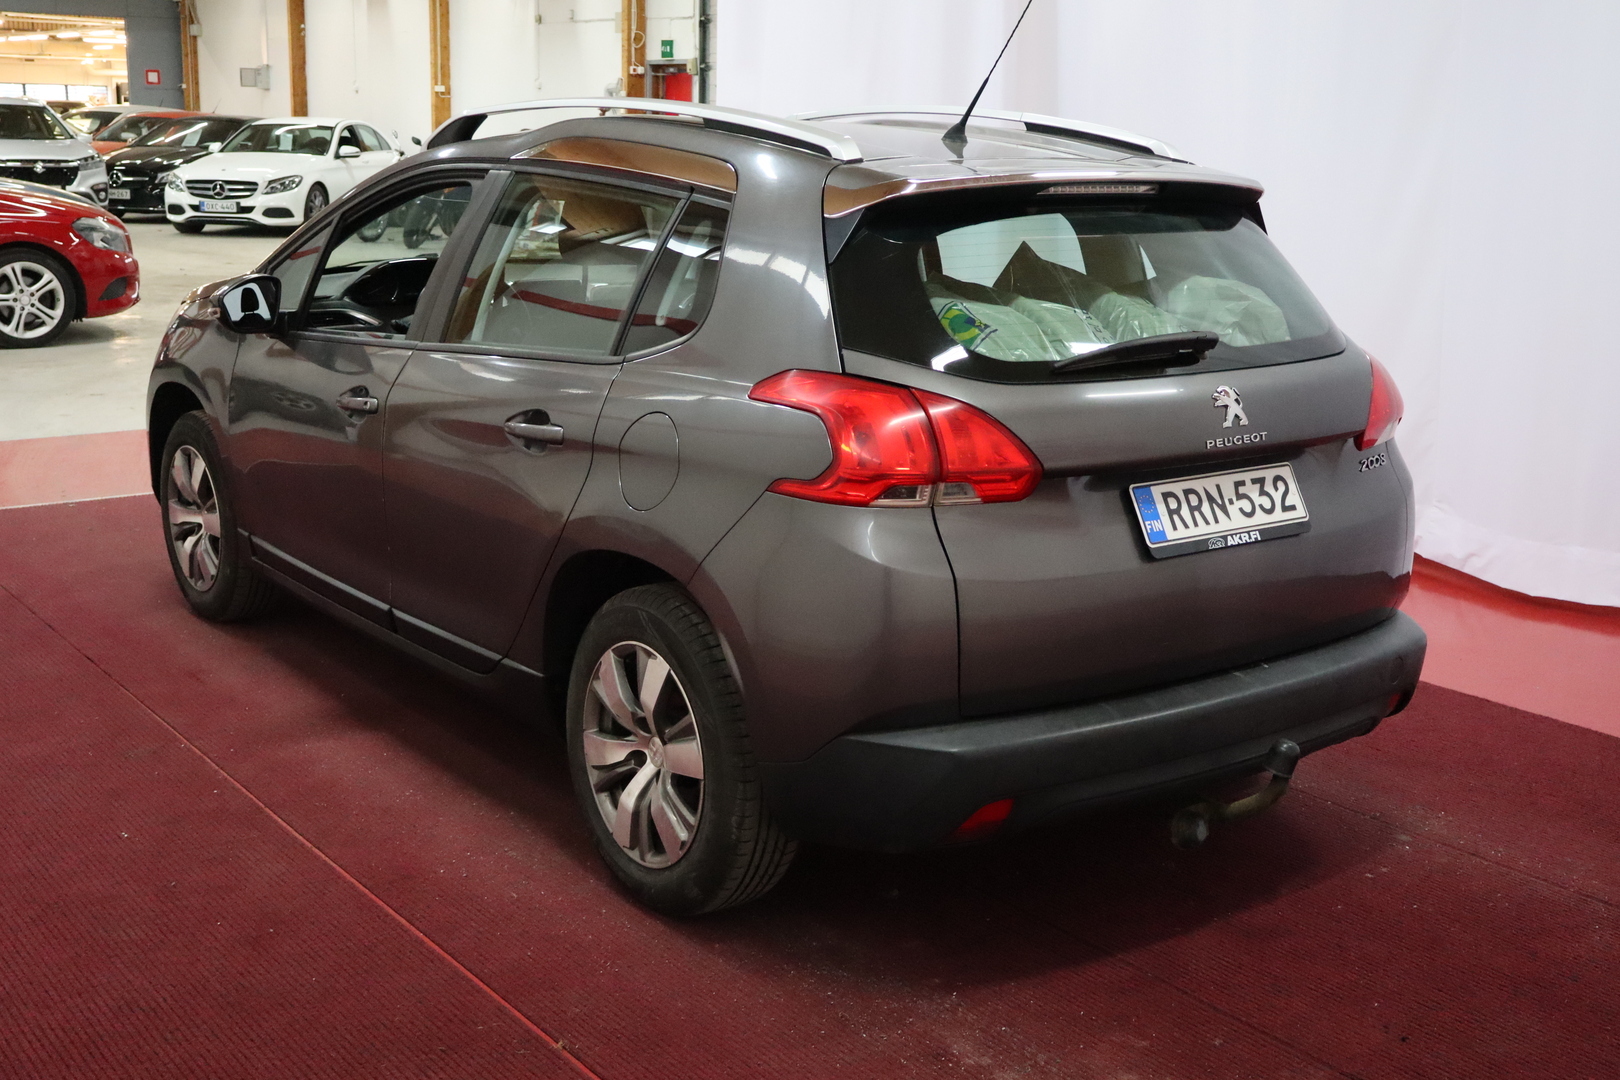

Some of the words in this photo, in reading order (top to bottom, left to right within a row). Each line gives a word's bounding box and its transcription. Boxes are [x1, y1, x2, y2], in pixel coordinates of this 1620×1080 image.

[1206, 431, 1268, 450] PEUGEOT
[1359, 452, 1386, 472] 2008
[1160, 474, 1298, 532] RRN-532
[1145, 519, 1164, 533] FIN
[1227, 530, 1261, 547] AKR.FI
